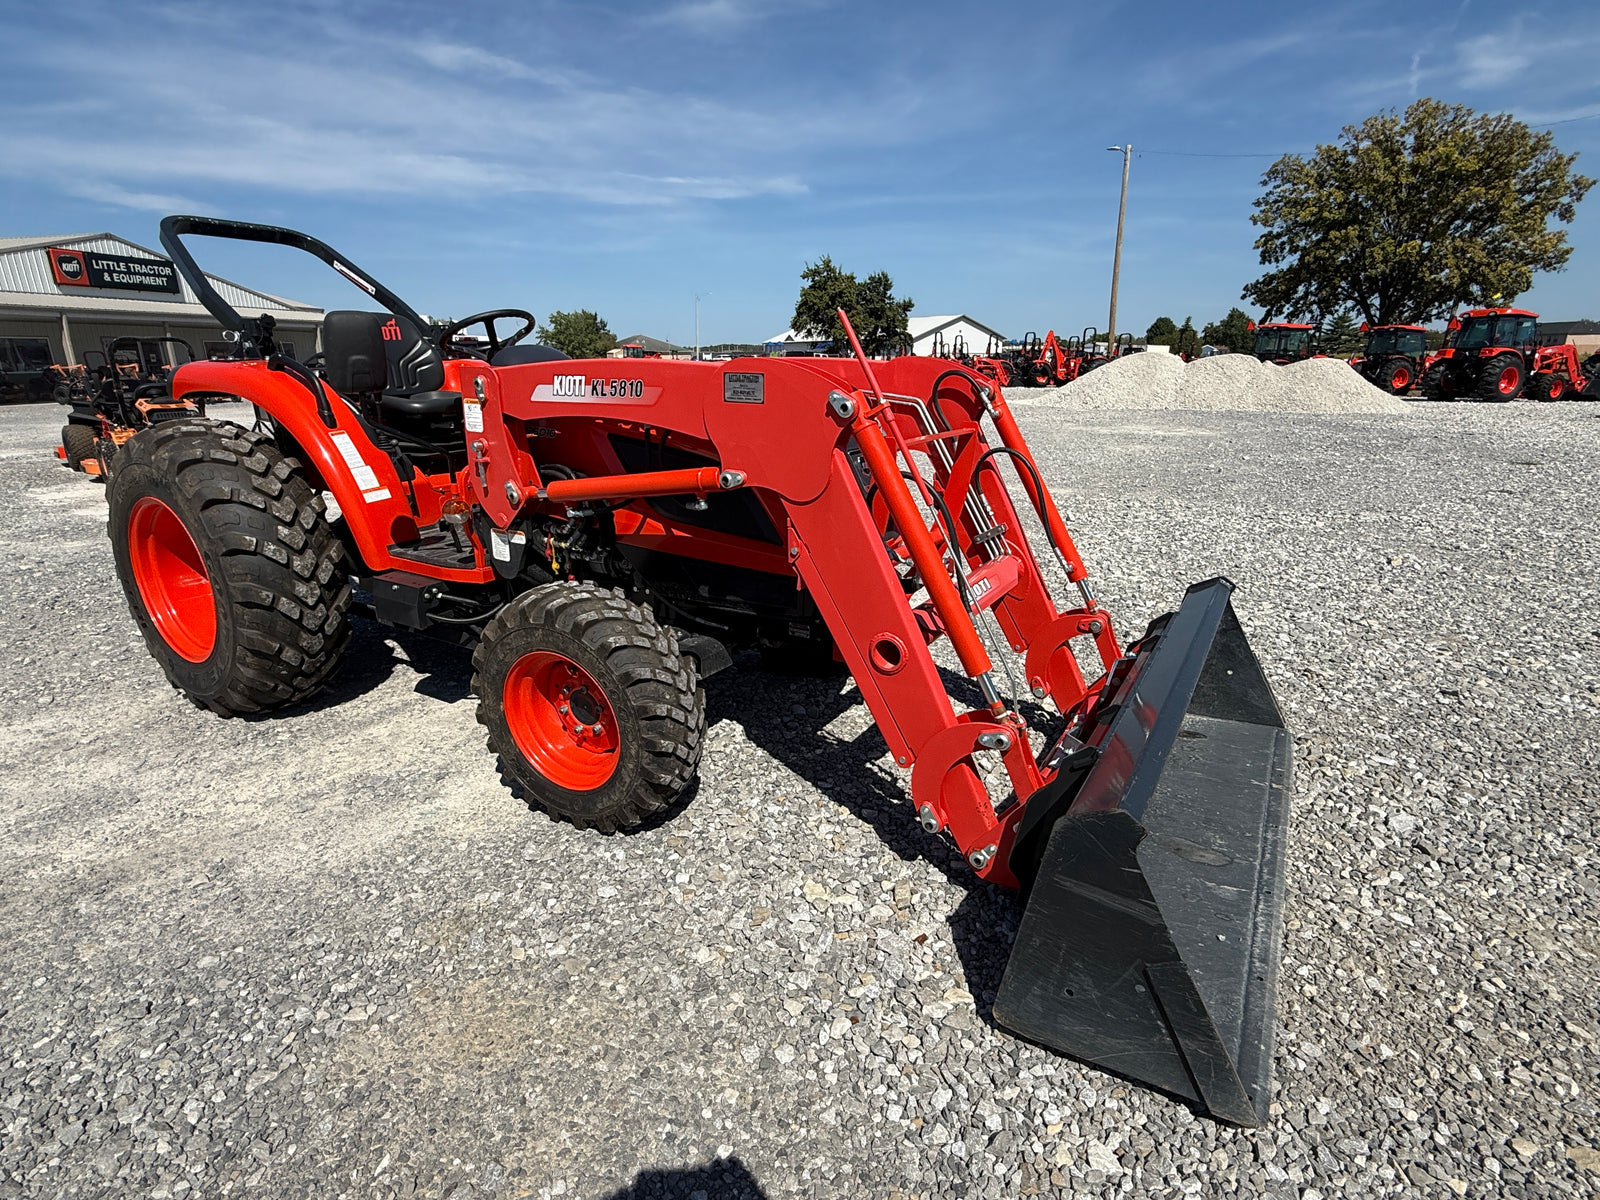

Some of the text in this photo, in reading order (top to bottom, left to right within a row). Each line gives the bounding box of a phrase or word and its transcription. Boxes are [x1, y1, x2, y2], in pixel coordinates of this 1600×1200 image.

[92, 259, 172, 276] LITTLE TRACTOR
[103, 273, 168, 286] & EQUIPMENT
[381, 326, 402, 341] OTI
[553, 375, 586, 396] KIOTI
